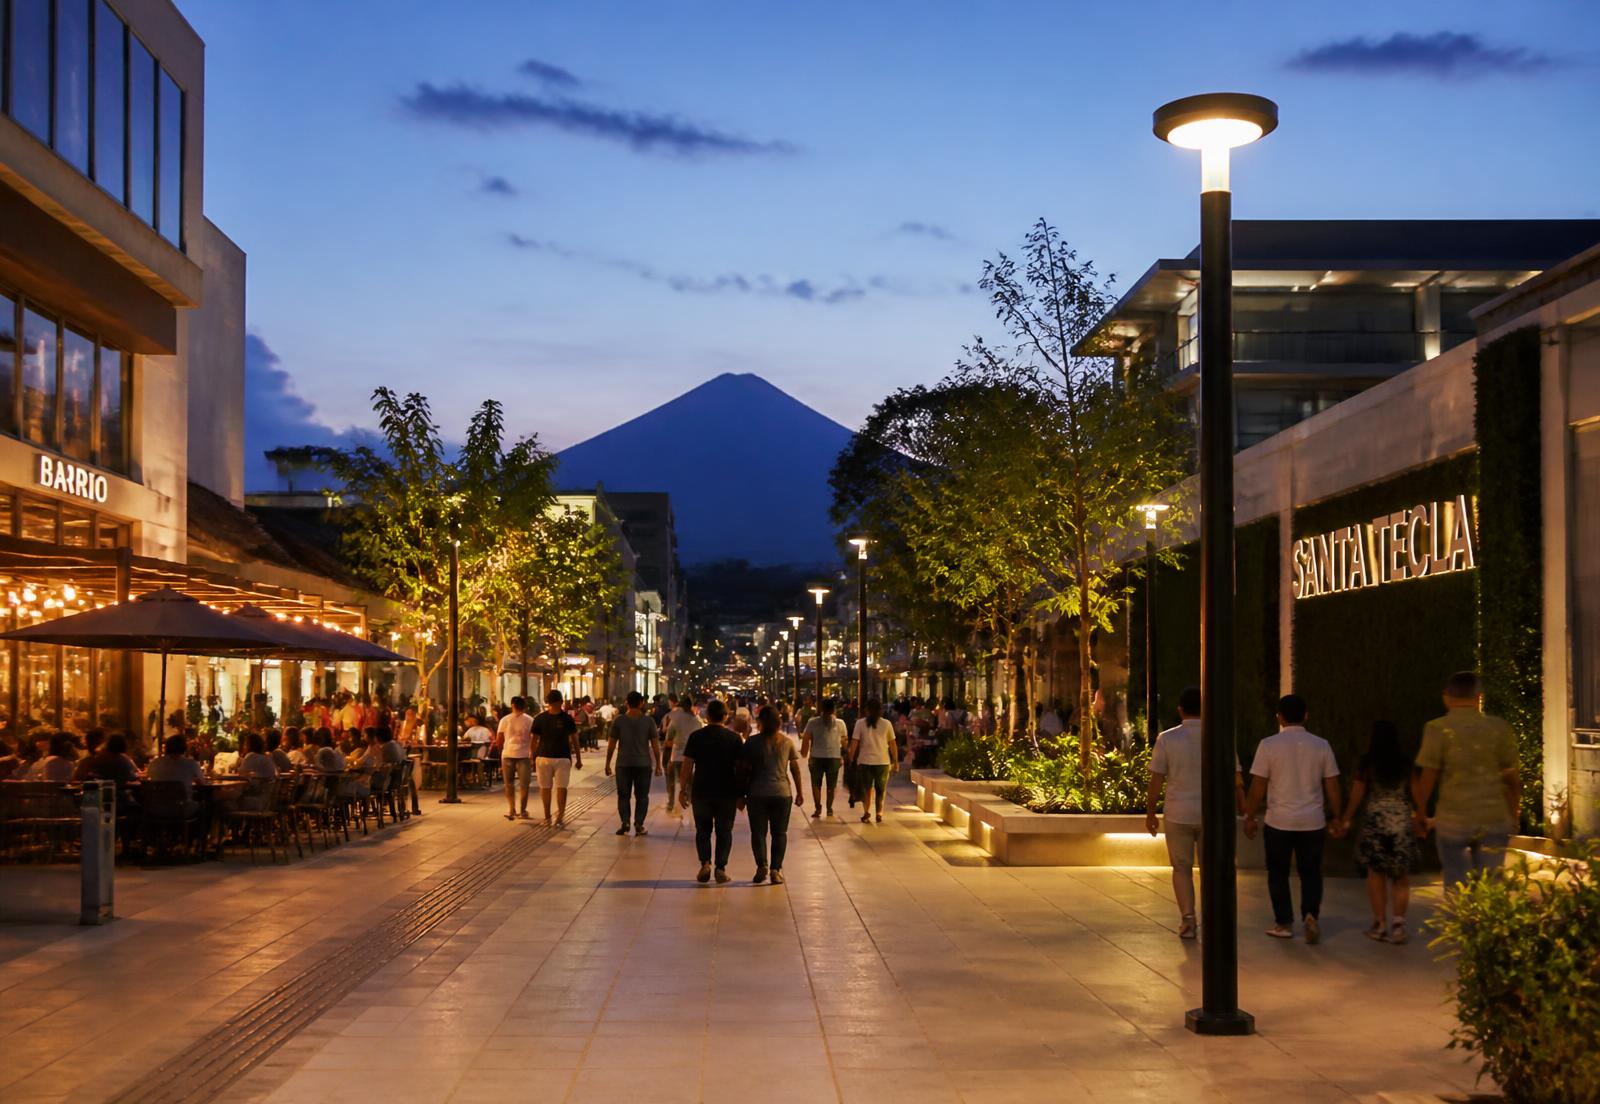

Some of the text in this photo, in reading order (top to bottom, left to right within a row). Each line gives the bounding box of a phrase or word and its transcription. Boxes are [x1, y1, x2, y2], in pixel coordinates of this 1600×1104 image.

[40, 455, 108, 502] BARRIO
[1293, 494, 1475, 599] SANTA TECLA
